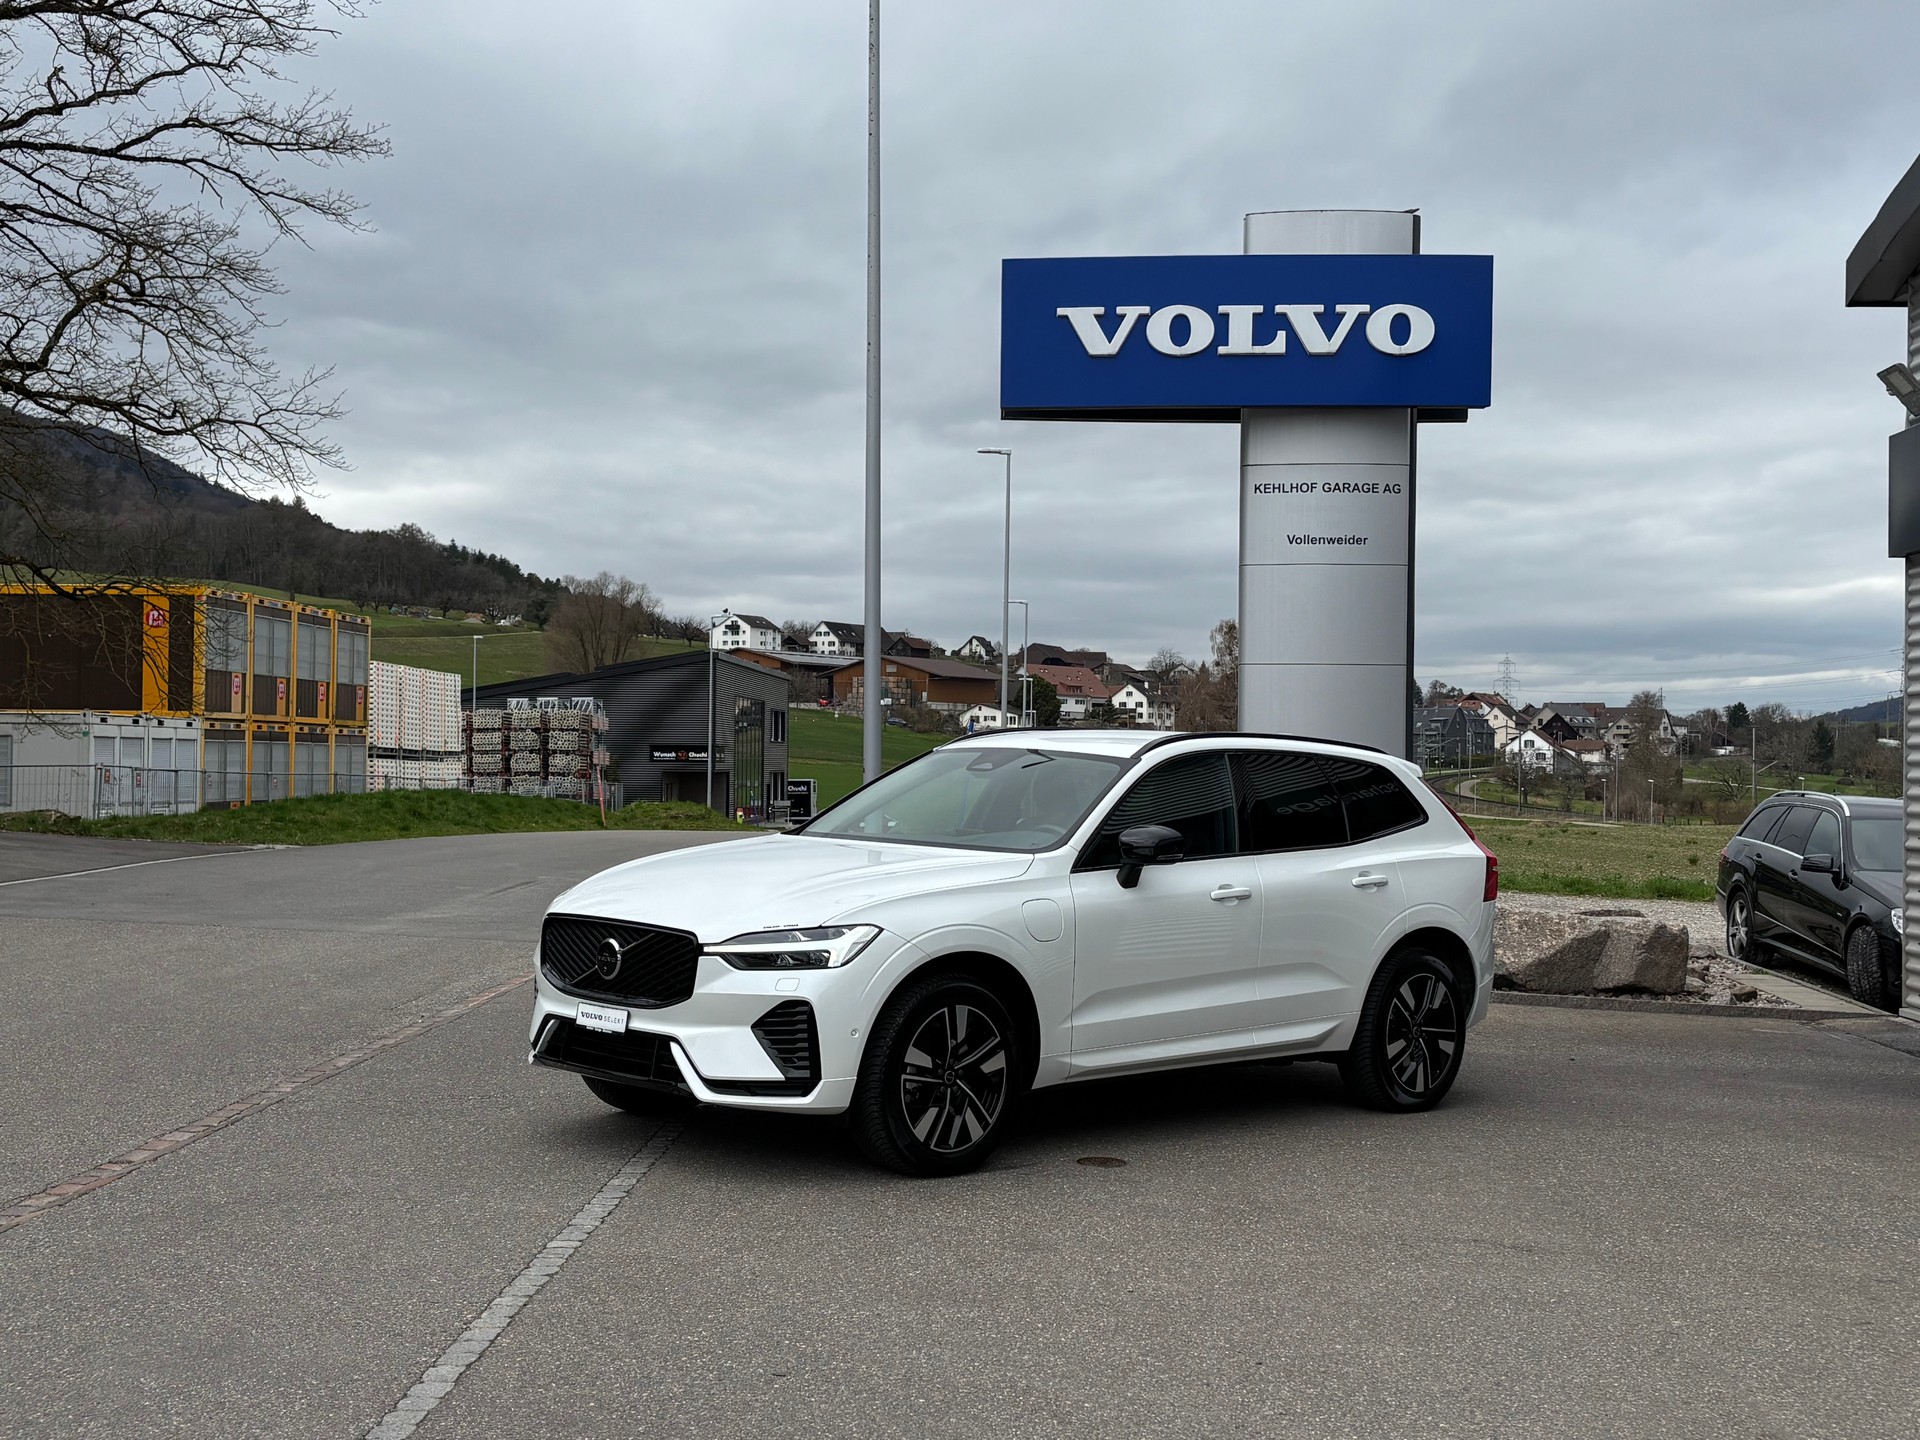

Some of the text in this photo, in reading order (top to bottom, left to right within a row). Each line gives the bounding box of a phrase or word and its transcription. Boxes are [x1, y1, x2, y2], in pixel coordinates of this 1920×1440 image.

[1056, 304, 1435, 356] VOLVO
[1254, 482, 1402, 495] KEHLHOF GARAGE AG
[1286, 534, 1369, 546] Vollenweider
[580, 1011, 603, 1021] VOLVO
